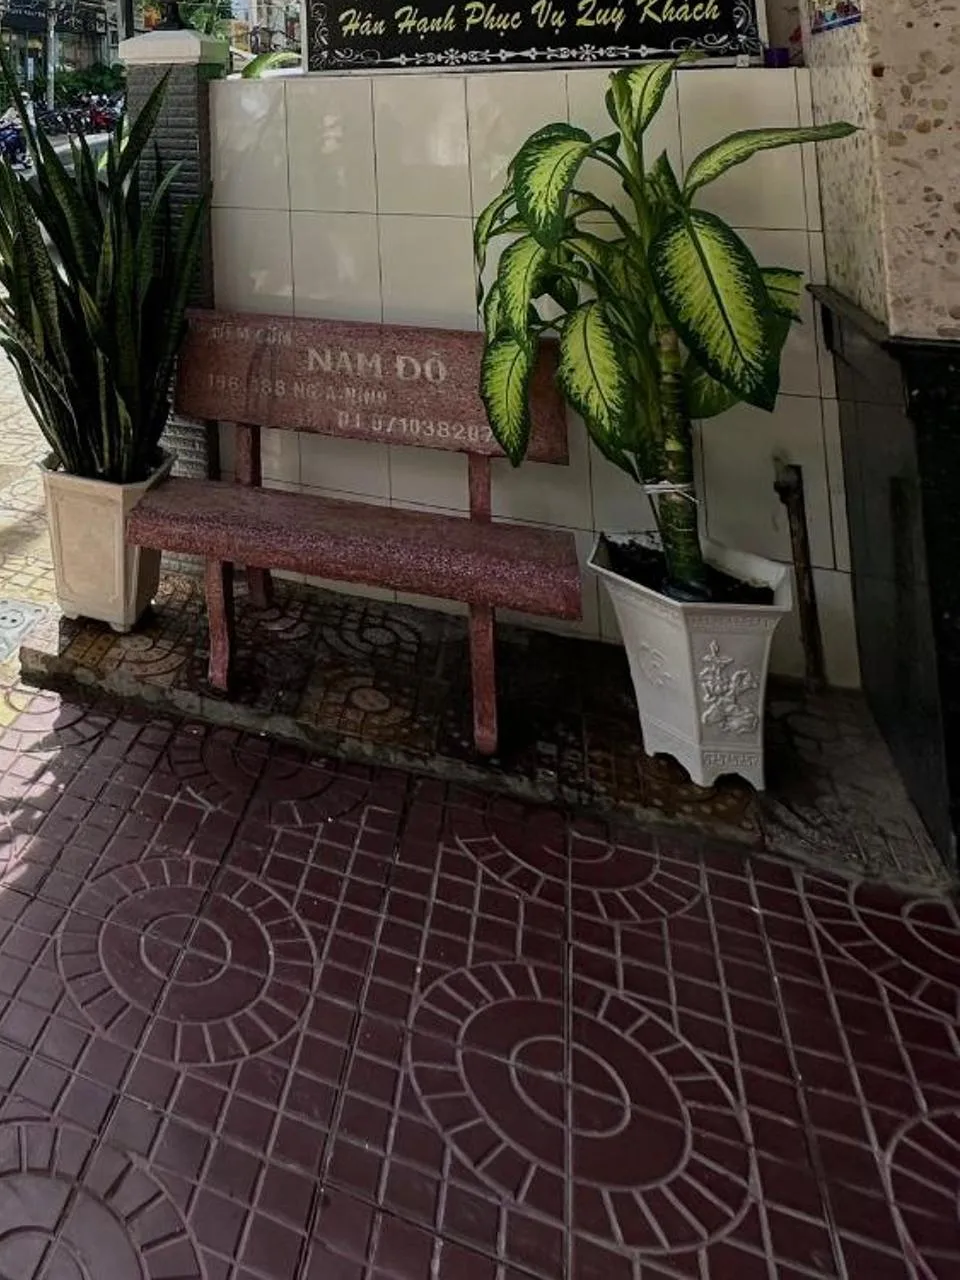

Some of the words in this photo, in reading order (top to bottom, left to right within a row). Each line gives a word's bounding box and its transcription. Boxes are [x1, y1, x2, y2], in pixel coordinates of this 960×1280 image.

[339, 8, 386, 37] Hân
[394, 4, 455, 40] Hạnh
[464, 1, 522, 36] Phục
[307, 347, 383, 380] NAM
[395, 352, 447, 383] ĐÔ
